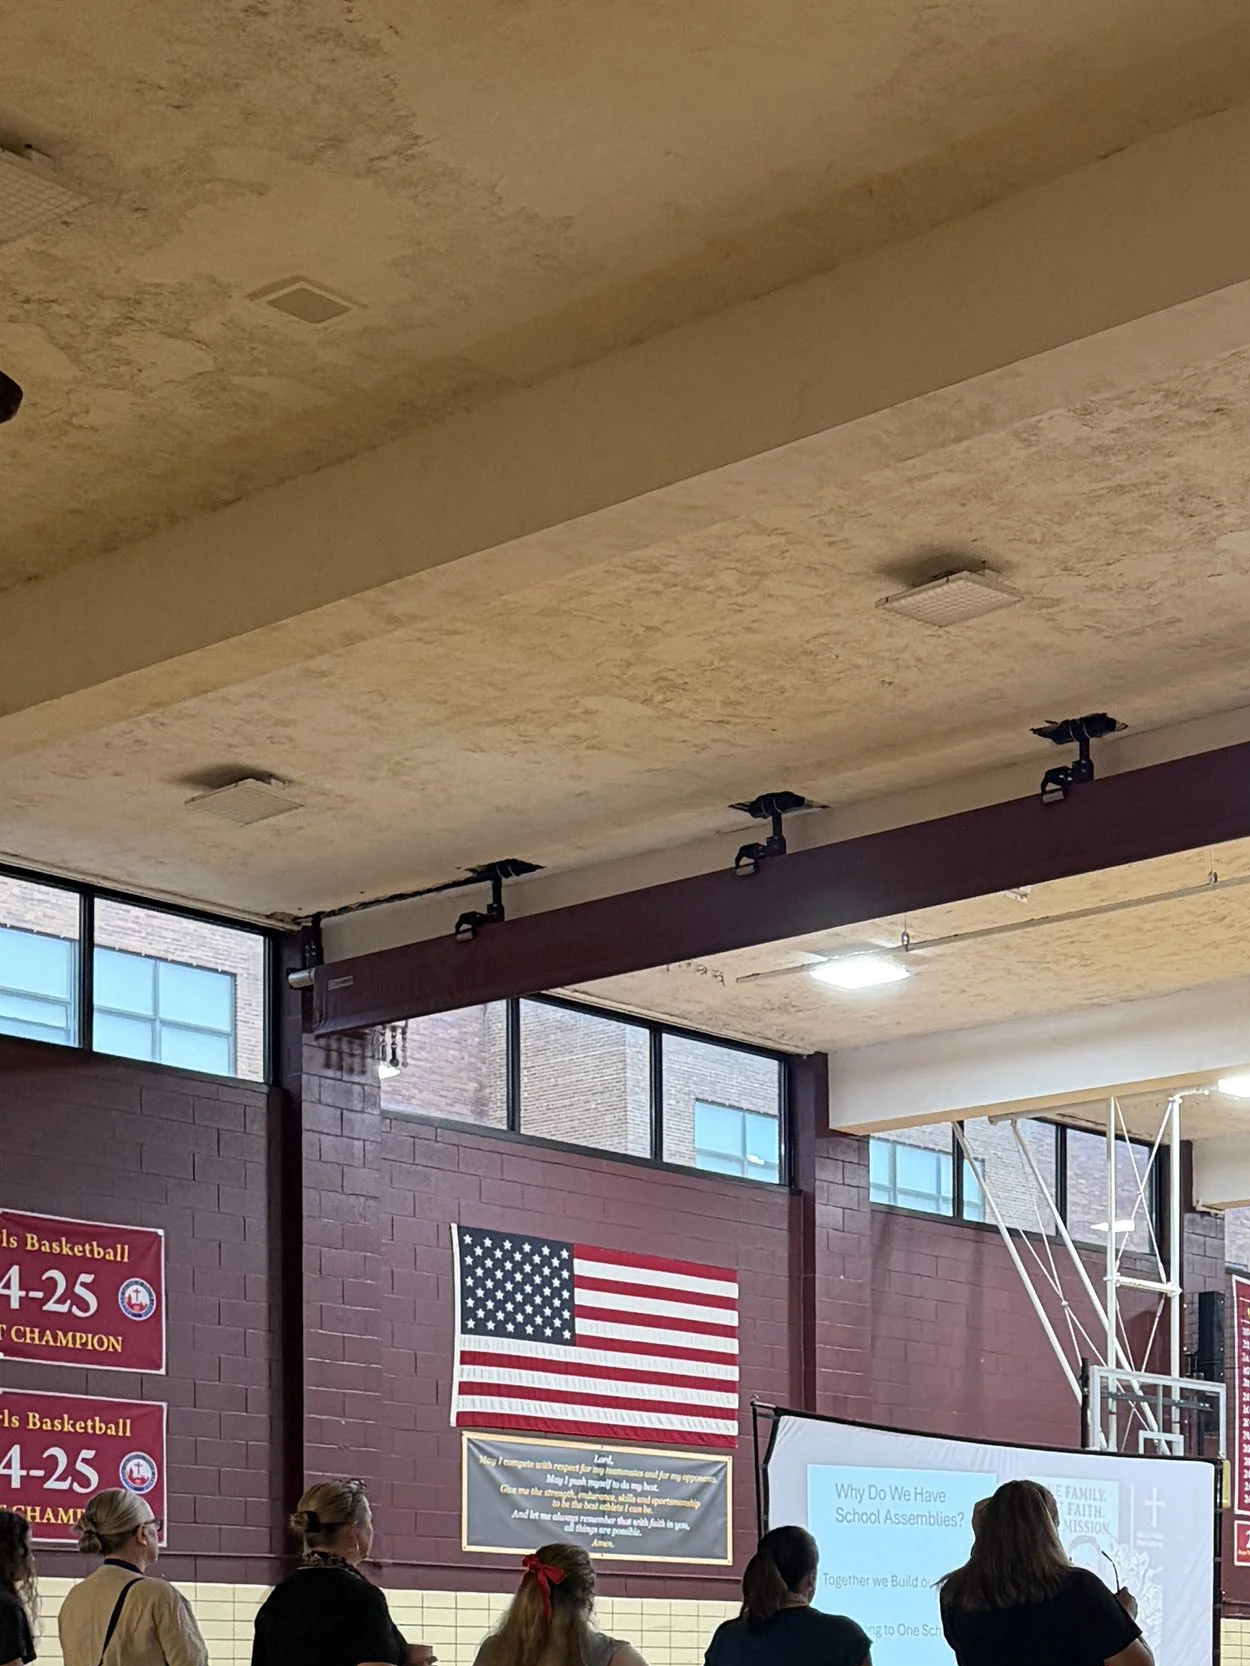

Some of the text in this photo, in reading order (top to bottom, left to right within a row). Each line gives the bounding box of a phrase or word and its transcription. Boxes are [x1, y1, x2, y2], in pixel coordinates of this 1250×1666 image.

[25, 1233, 129, 1262] Basketball
[10, 1326, 123, 1352] CHAMPION
[26, 1412, 132, 1436] Basketball
[480, 1454, 495, 1467] May
[498, 1456, 502, 1466] I
[504, 1458, 534, 1469] compete
[536, 1460, 552, 1470] with
[554, 1462, 578, 1473] respect
[580, 1464, 591, 1474] for
[592, 1466, 604, 1476] my
[606, 1467, 643, 1478] teammates
[644, 1470, 658, 1478] and
[658, 1470, 670, 1480] for
[670, 1474, 681, 1482] my
[594, 1454, 614, 1466] Lord,
[546, 1474, 562, 1486] May
[564, 1476, 568, 1484] I
[569, 1476, 586, 1487] push
[588, 1479, 612, 1490] myself
[612, 1480, 620, 1488] to
[620, 1480, 630, 1489] do
[631, 1482, 642, 1492] my
[500, 1484, 516, 1494] Give
[518, 1488, 529, 1496] me
[530, 1488, 542, 1496] the
[618, 1494, 636, 1503] skills
[637, 1496, 650, 1505] and
[652, 1498, 700, 1510] sportsmanship
[835, 1483, 946, 1504] Why Do We Have
[1065, 1486, 1107, 1502] FAMILY.
[552, 1500, 560, 1508] to
[562, 1498, 570, 1508] be
[572, 1500, 582, 1509] the
[584, 1500, 598, 1510] best
[600, 1502, 624, 1512] athlete
[624, 1504, 628, 1512] I
[1068, 1502, 1105, 1518] FAITH.
[511, 1510, 528, 1519] And
[530, 1510, 538, 1520] let
[552, 1512, 578, 1524] always
[580, 1514, 616, 1524] remember
[617, 1517, 632, 1526] that
[633, 1518, 648, 1526] with
[648, 1518, 666, 1528] faith
[667, 1520, 674, 1528] in
[835, 1507, 965, 1527] School Assemblies?
[564, 1521, 574, 1532] all
[576, 1524, 598, 1535] things
[822, 1573, 870, 1588] Together
[872, 1578, 888, 1586] we
[891, 1574, 918, 1588] Build
[884, 1625, 894, 1636] to
[897, 1624, 920, 1636] One
[922, 1624, 942, 1636] Sch
